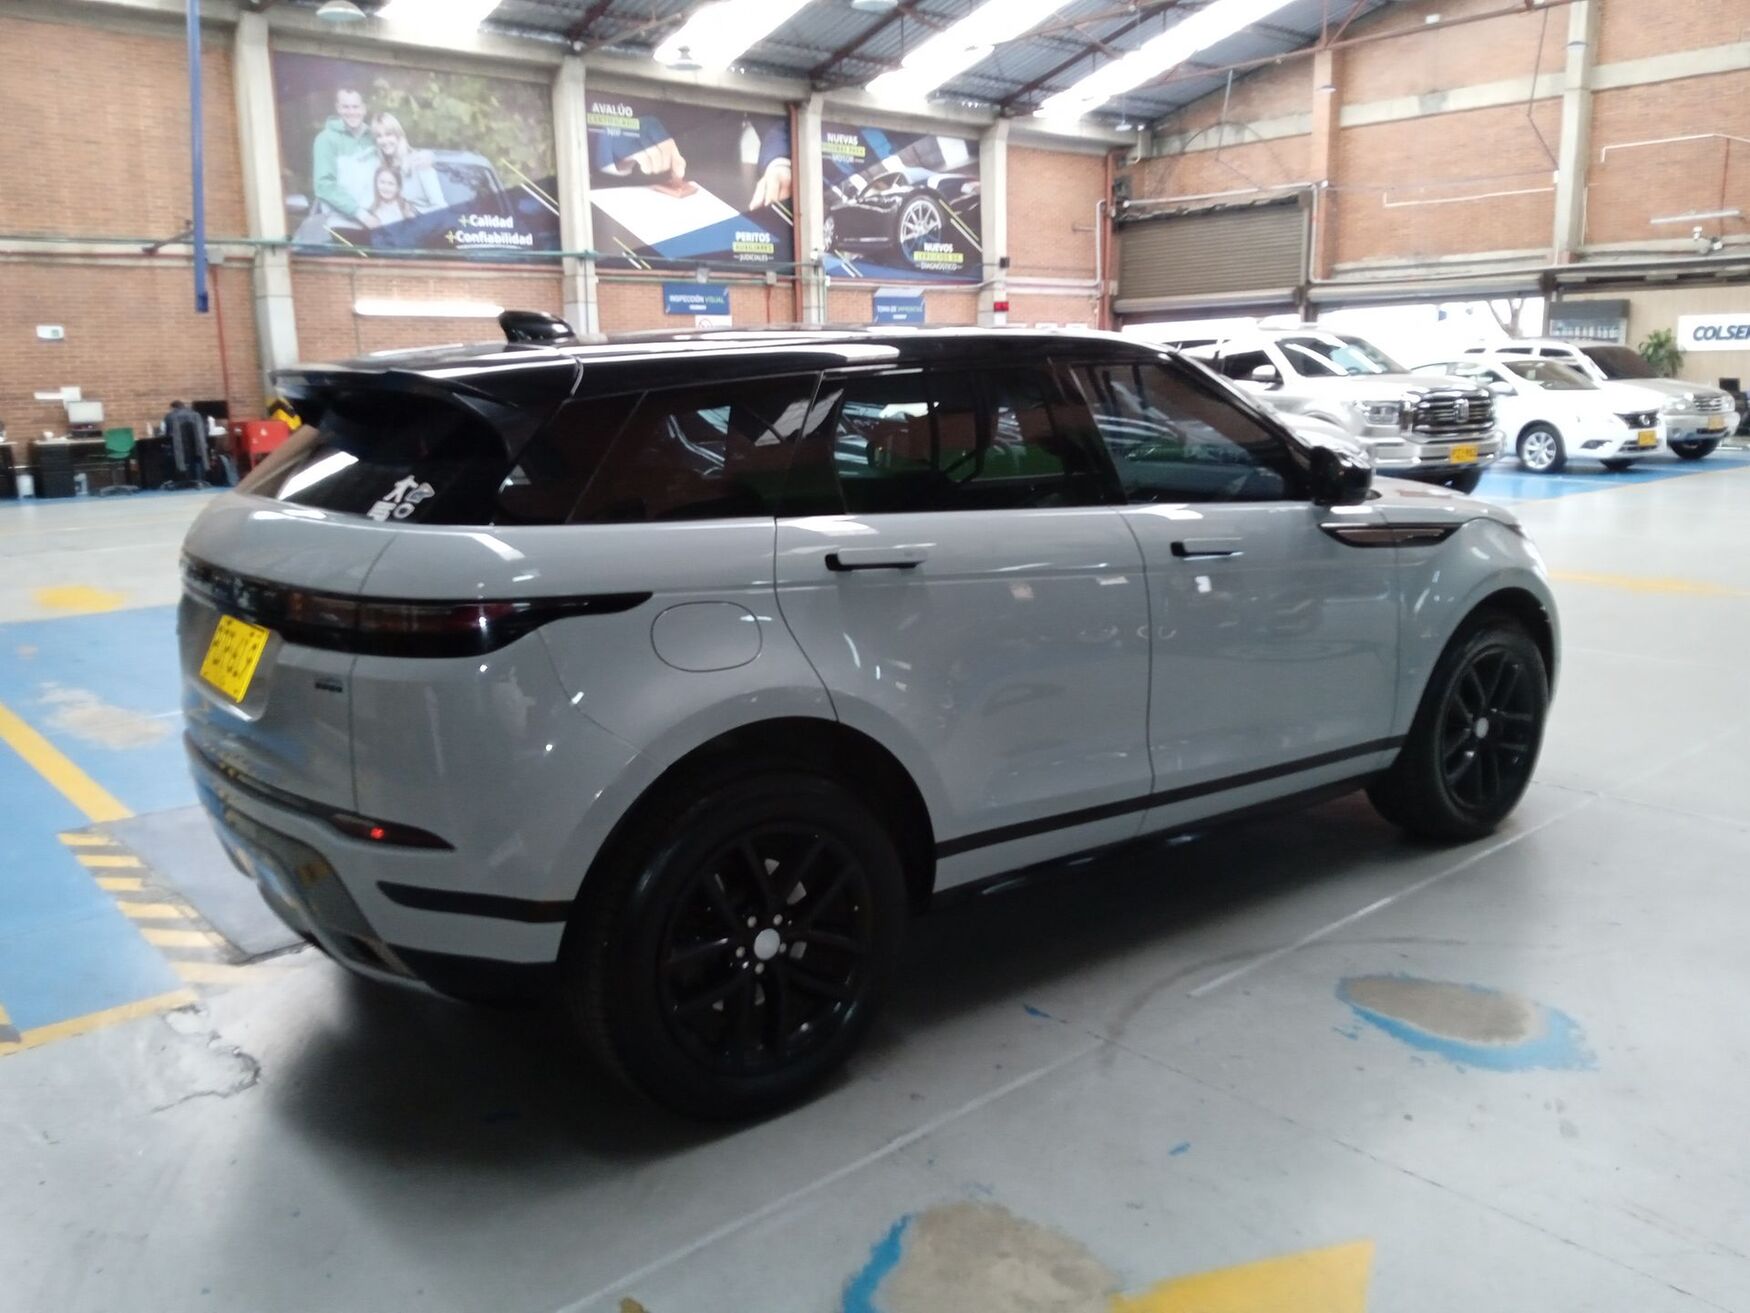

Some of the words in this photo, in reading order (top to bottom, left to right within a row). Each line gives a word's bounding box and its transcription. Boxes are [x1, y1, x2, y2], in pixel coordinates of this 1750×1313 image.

[592, 102, 634, 117] AVALÚO
[827, 132, 858, 146] NUEVAS
[735, 231, 770, 243] PERITOS
[923, 242, 953, 253] NUEVOS
[1693, 325, 1750, 341] COLSE
